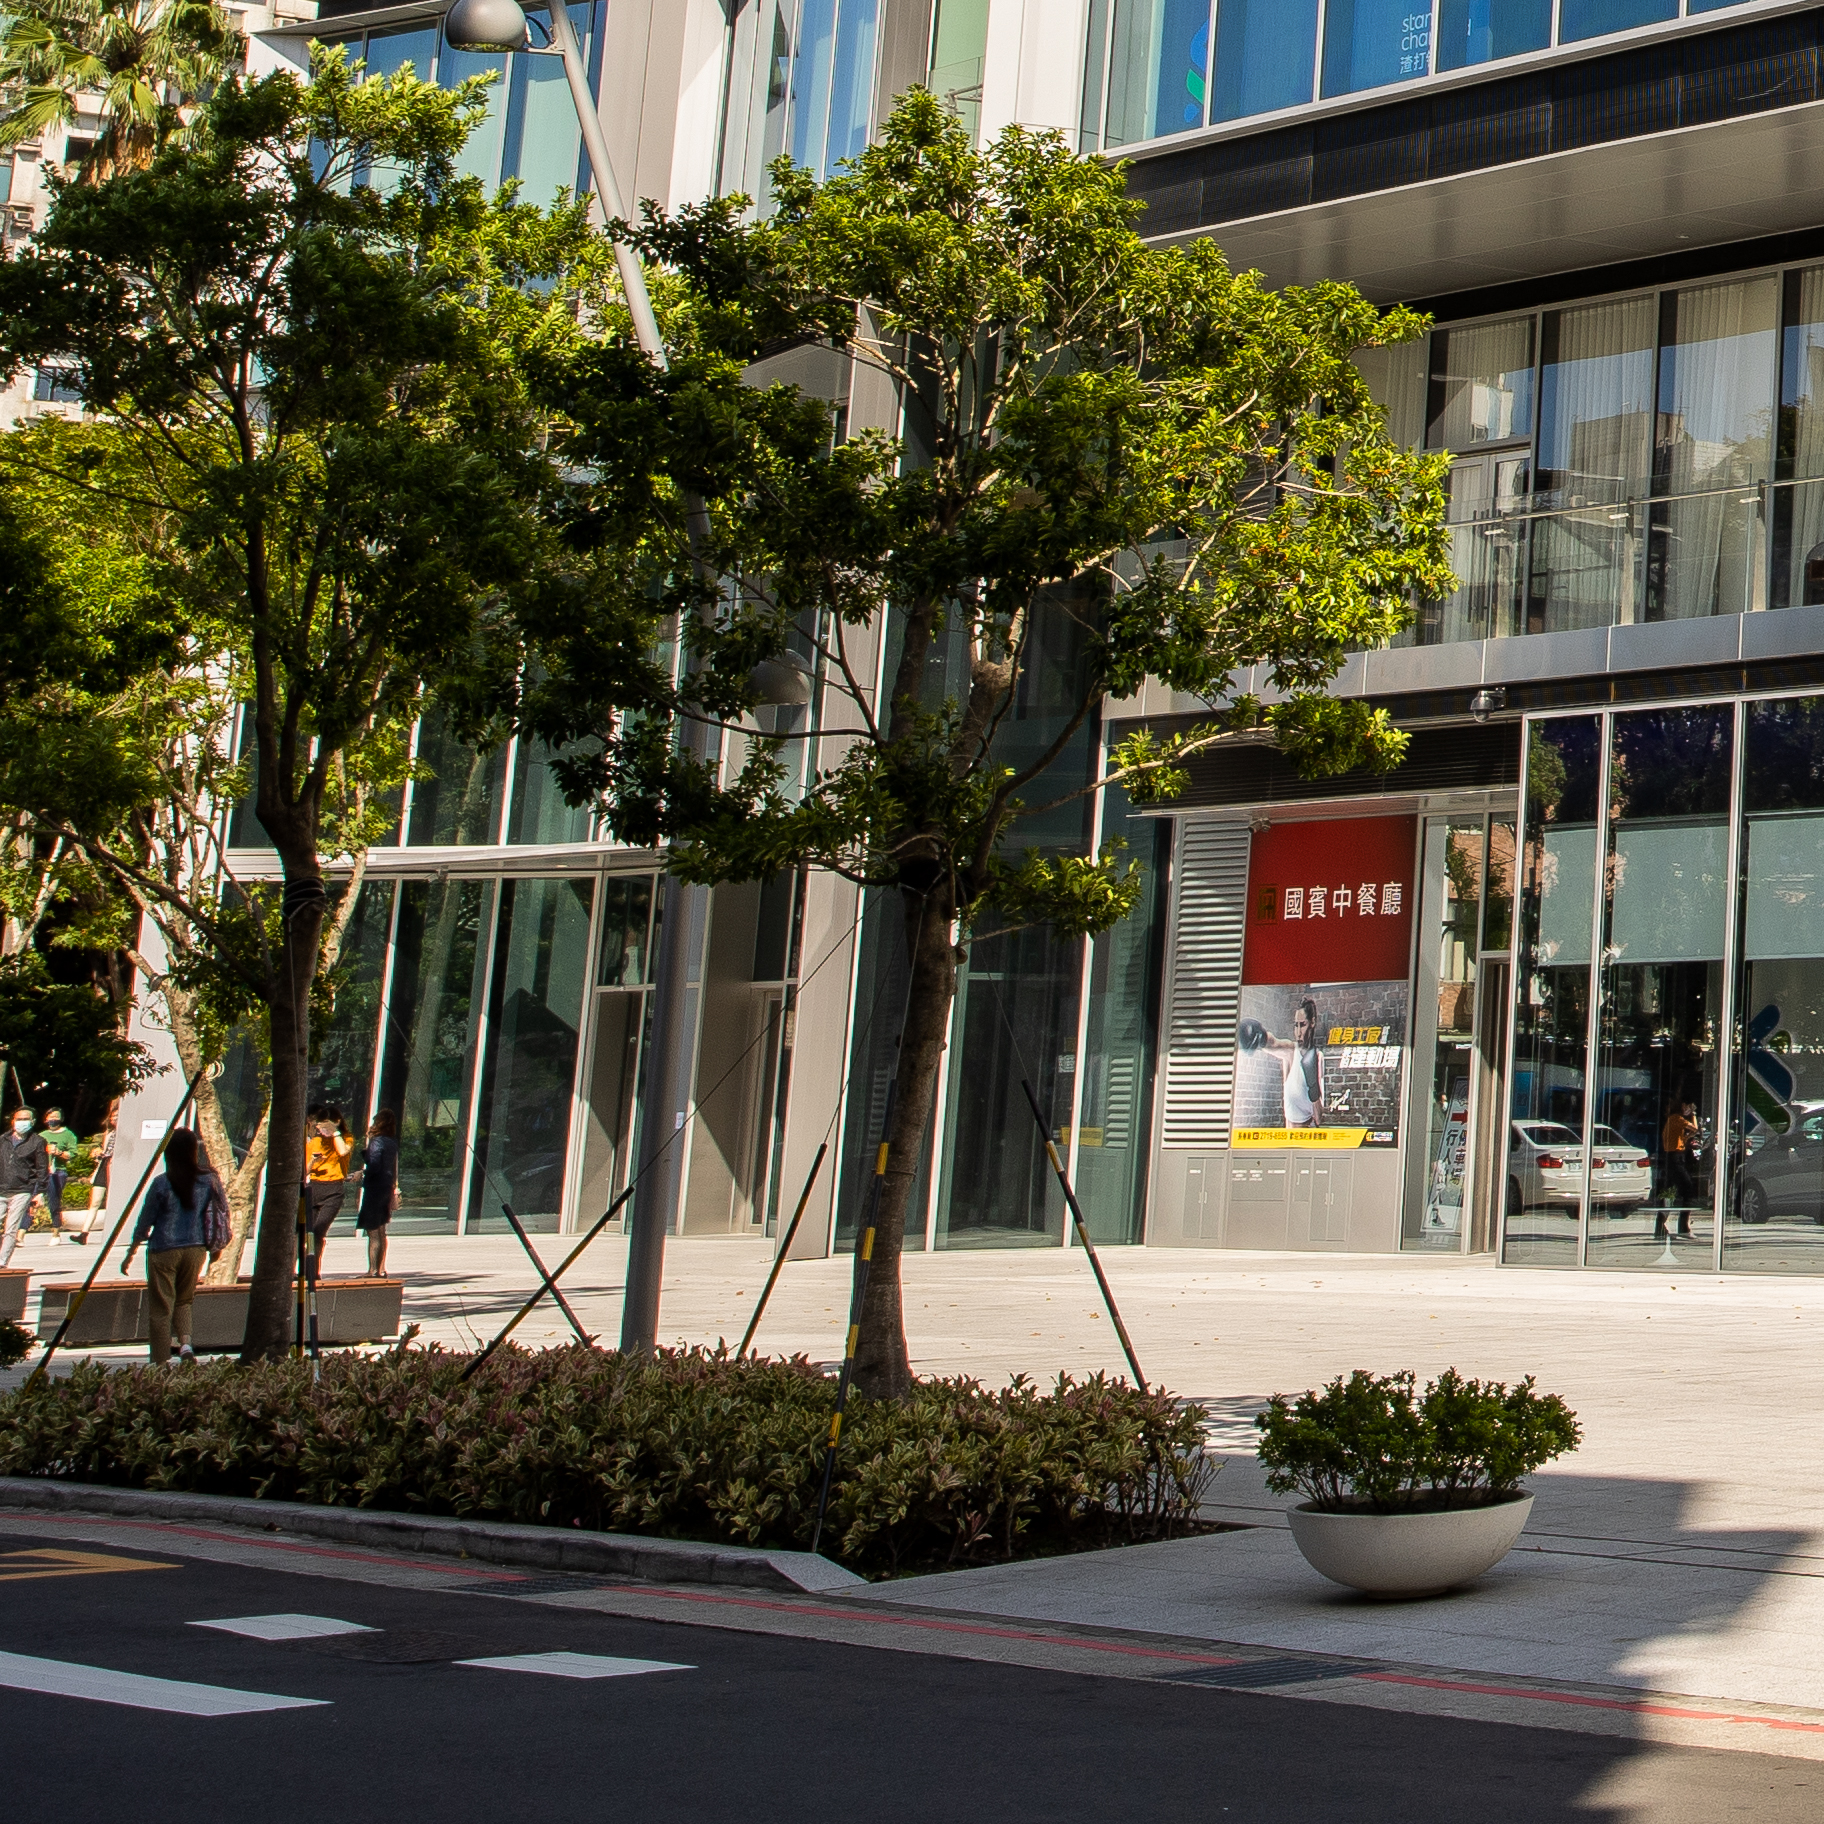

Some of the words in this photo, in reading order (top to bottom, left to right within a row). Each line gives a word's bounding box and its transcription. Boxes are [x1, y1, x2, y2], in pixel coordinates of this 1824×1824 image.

[1283, 880, 1403, 920] 國賓中餐廳
